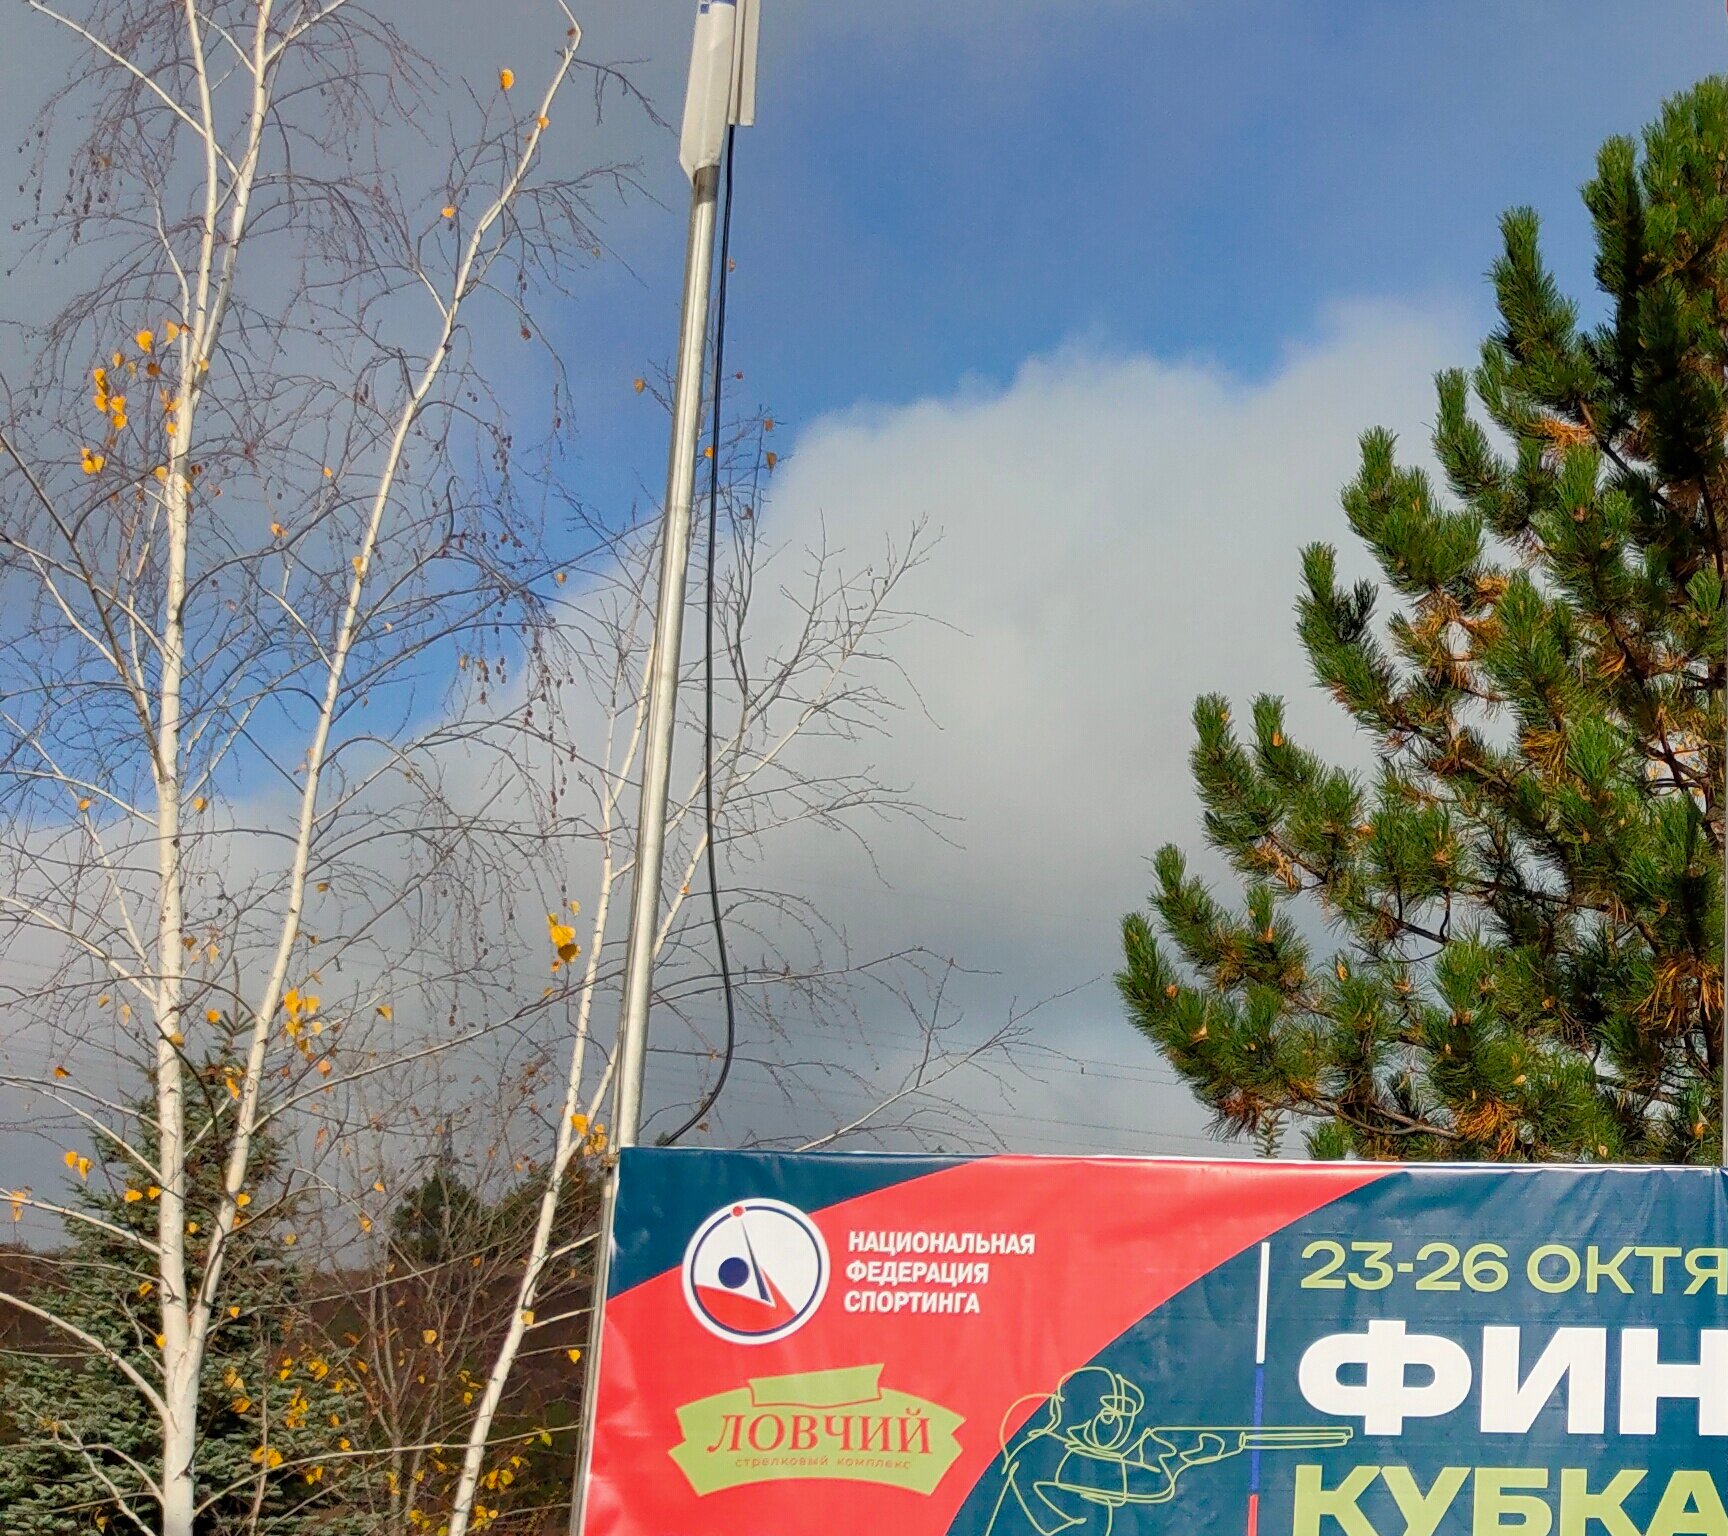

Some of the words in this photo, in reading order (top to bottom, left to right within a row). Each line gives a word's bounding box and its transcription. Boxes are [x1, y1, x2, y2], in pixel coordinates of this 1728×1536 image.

[848, 1230, 1035, 1256] НАЦИОНАЛЬНАЯ
[845, 1260, 989, 1287] ФЕДЕРАЦИЯ
[1300, 1240, 1510, 1292] 23-26
[844, 1291, 980, 1313] СПОРТИНГА
[706, 1407, 932, 1454] ЛОВЧИЙ
[735, 1455, 829, 1468] стрелковый
[837, 1457, 912, 1470] комплекс
